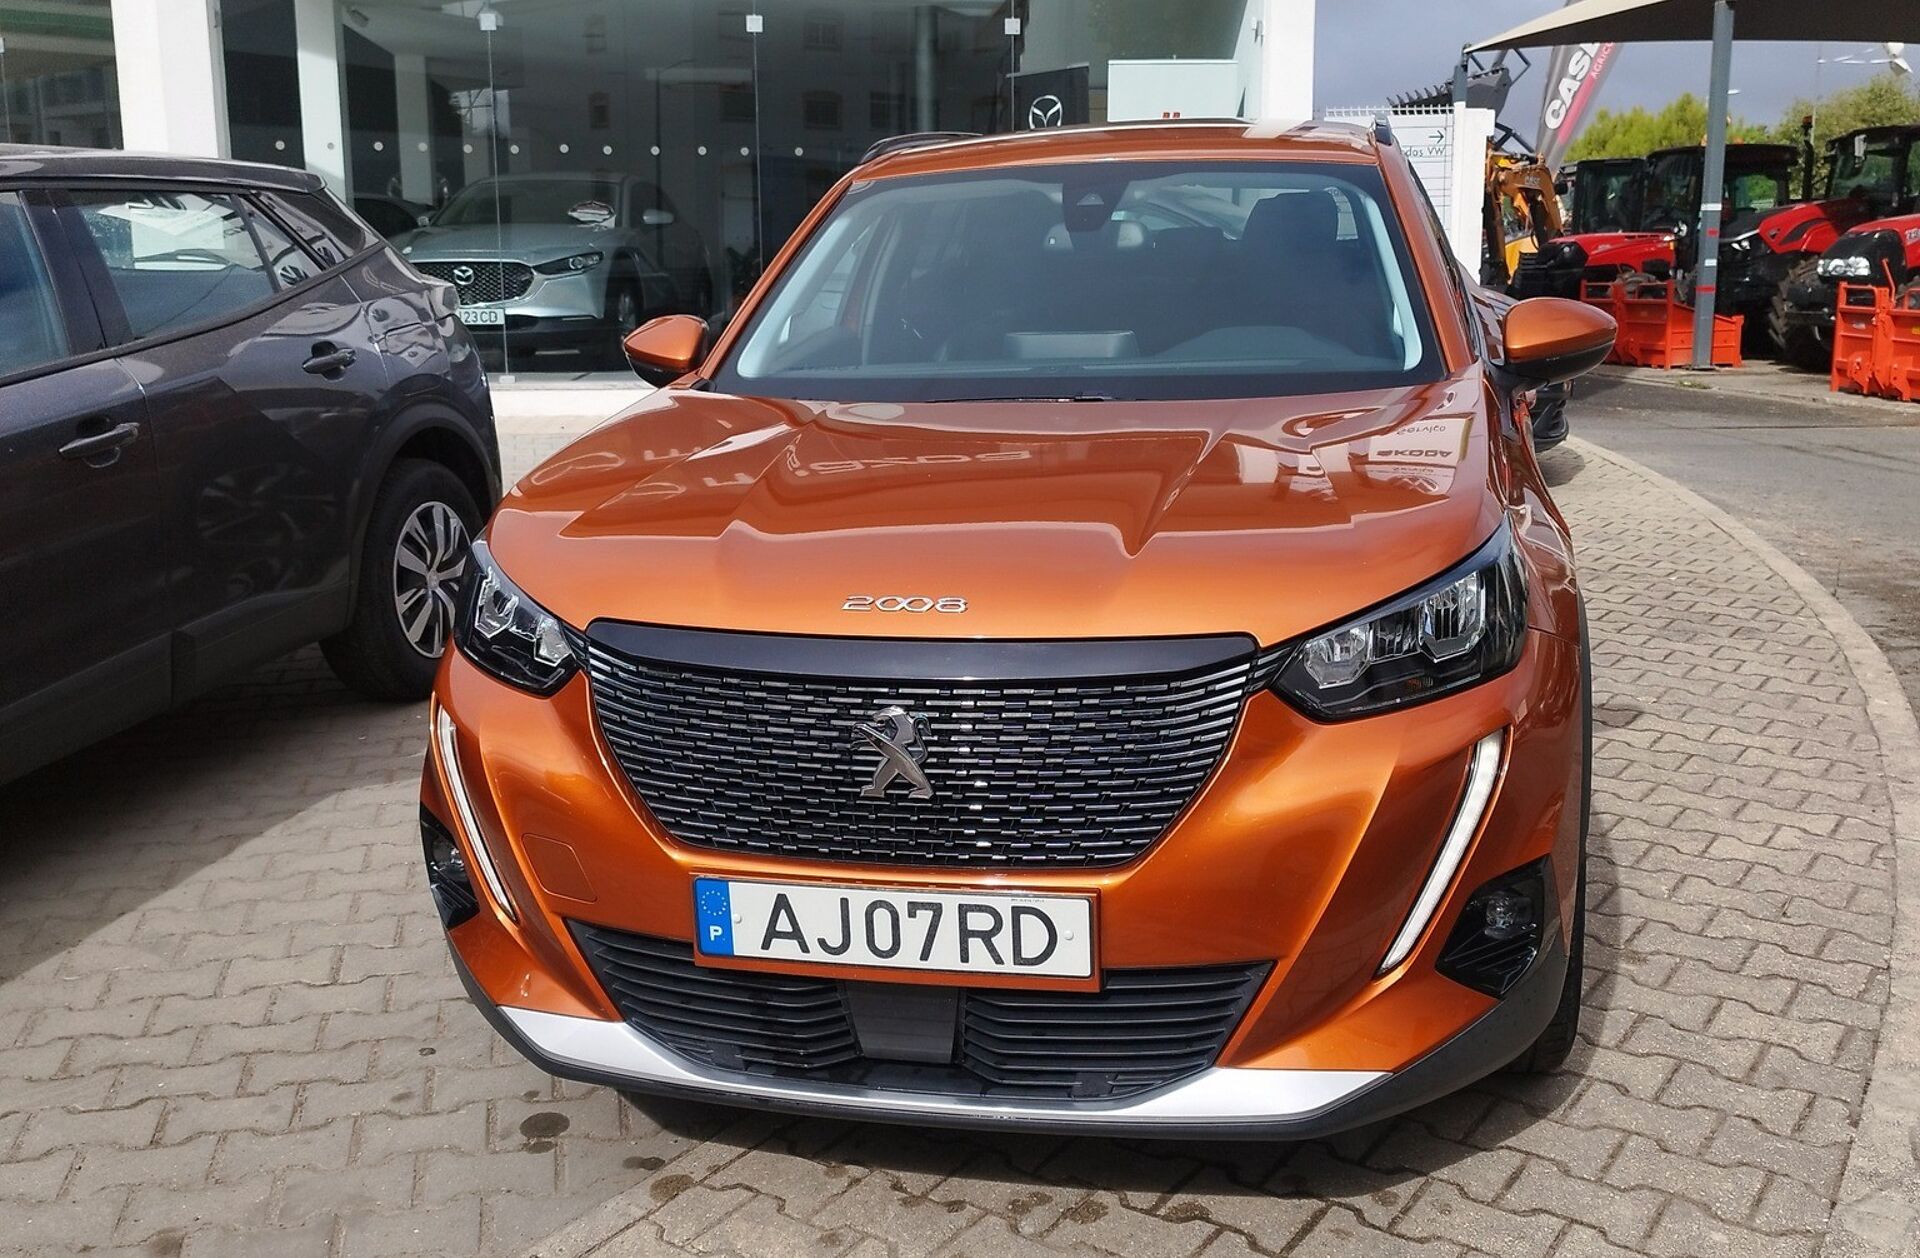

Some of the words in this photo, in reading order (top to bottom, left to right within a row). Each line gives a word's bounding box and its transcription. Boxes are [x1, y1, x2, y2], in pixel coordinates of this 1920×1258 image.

[1402, 146, 1423, 157] dos
[1428, 147, 1446, 156] VW
[842, 594, 968, 614] 2008
[710, 926, 722, 941] P
[760, 893, 1058, 967] AJ07RD
